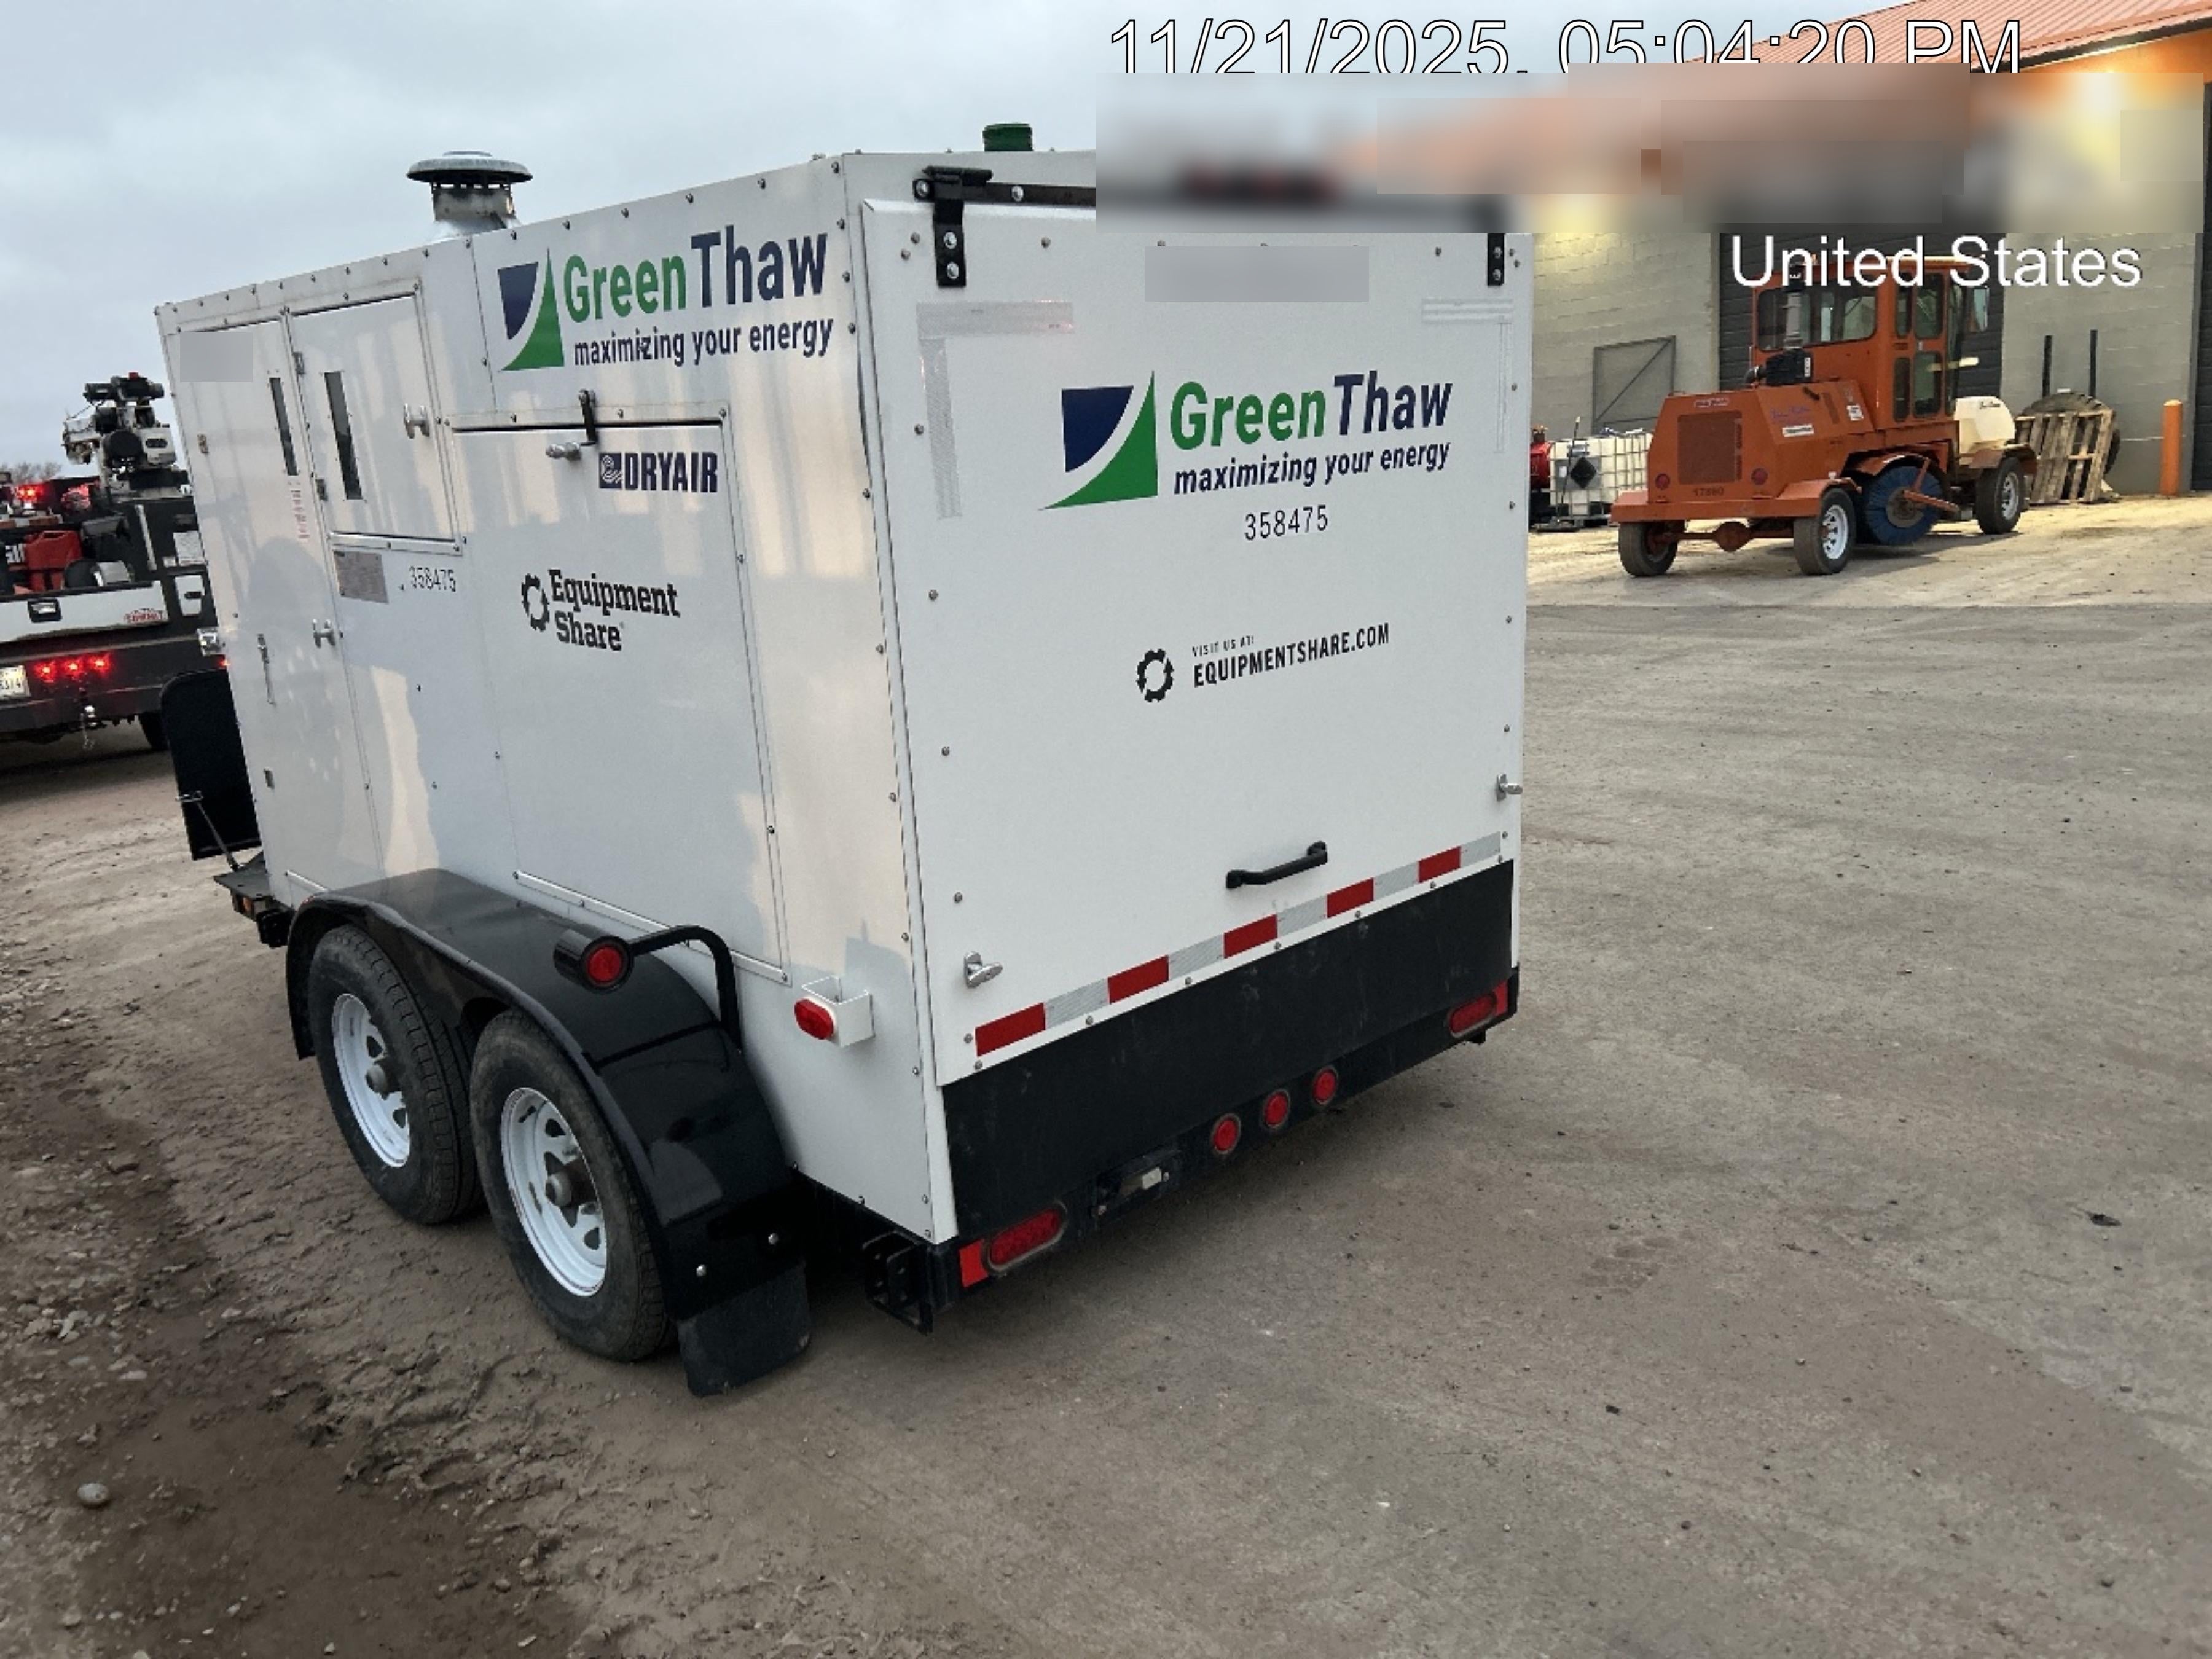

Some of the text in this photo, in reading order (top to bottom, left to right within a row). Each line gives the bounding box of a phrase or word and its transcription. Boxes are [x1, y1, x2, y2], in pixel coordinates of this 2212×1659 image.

[574, 318, 834, 367] maximizing your energy
[624, 451, 718, 493] DRYAIR
[1174, 442, 1451, 495] maximizing your energy
[1244, 504, 1328, 541] 358475
[409, 565, 457, 593] 358475
[548, 569, 681, 618] Equipment
[554, 610, 622, 651] Share
[1192, 641, 1219, 657] VISIT
[1223, 638, 1236, 651] US
[1193, 622, 1389, 688] EQUIPMENTSHARE.COM
